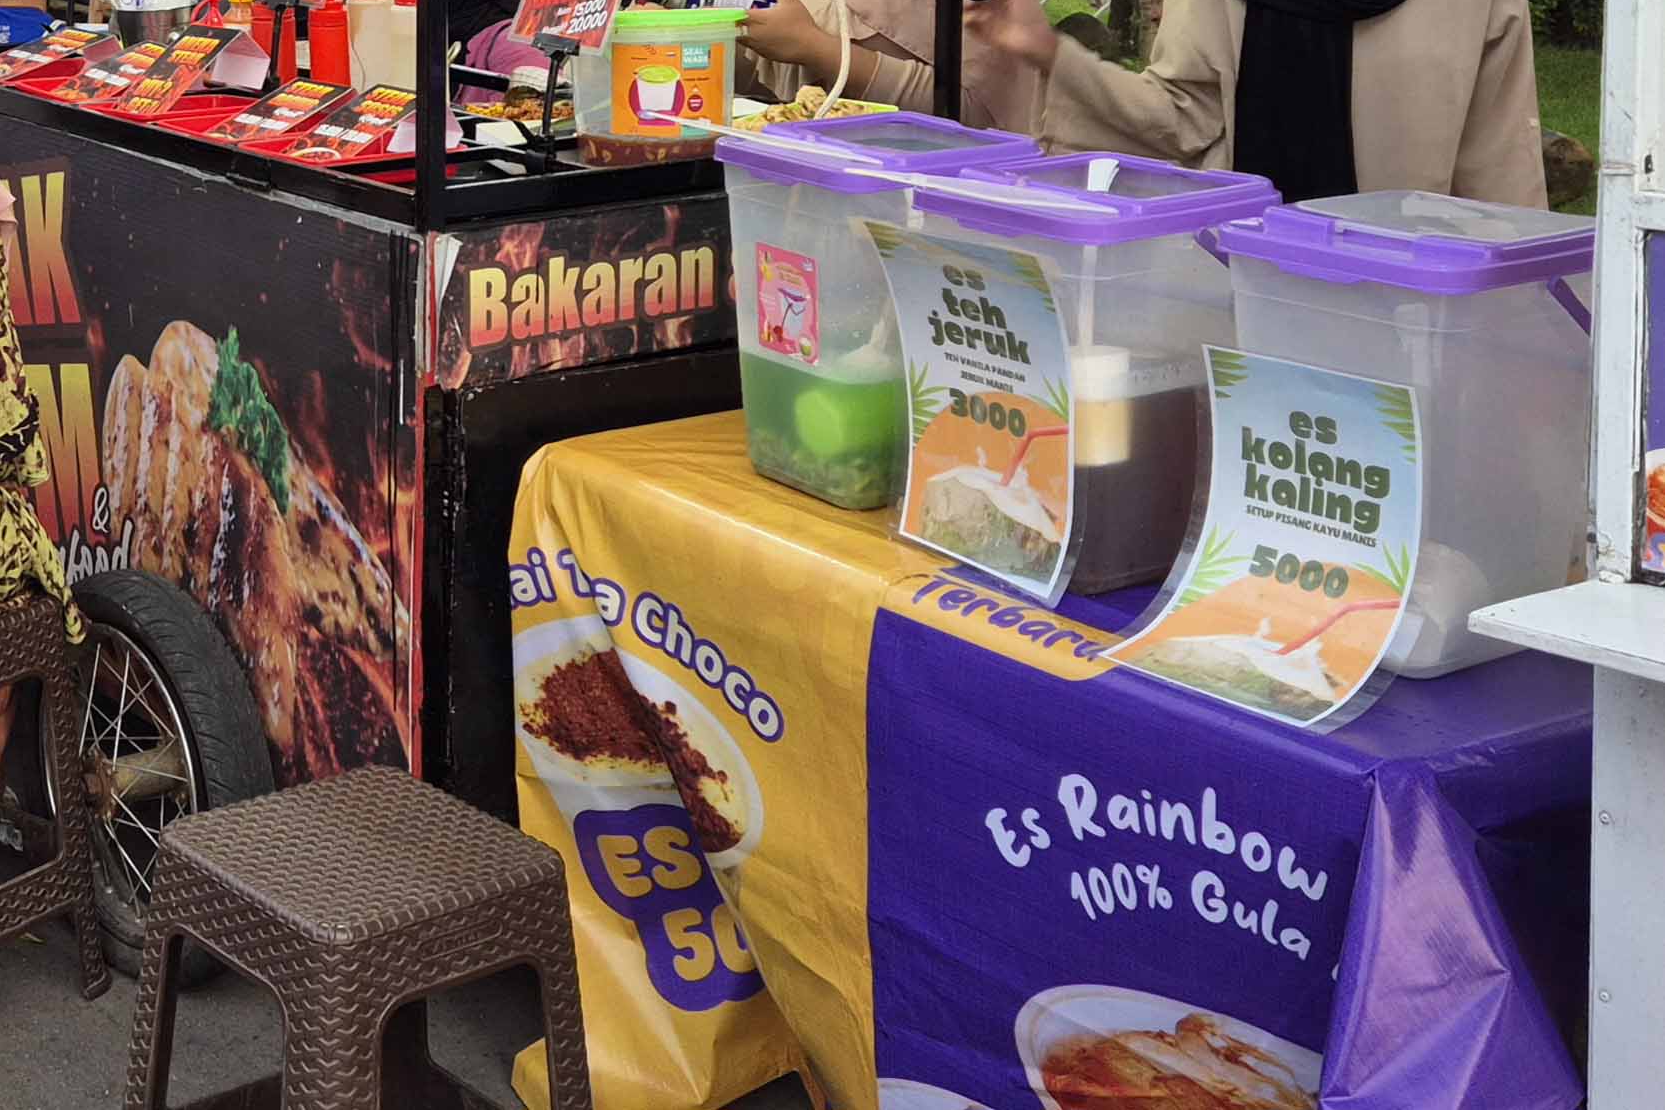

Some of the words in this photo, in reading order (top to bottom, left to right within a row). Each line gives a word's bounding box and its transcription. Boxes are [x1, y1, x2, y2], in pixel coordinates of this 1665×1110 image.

[469, 245, 715, 348] Bakaran
[942, 265, 986, 292] es
[942, 288, 1008, 330] teh
[927, 310, 1032, 365] jeruk
[949, 387, 1026, 437] 3000
[1288, 410, 1339, 445] es
[1241, 426, 1392, 499] kolang
[92, 487, 111, 533] &
[1243, 462, 1382, 534] kaling
[1246, 504, 1274, 520] SETUP
[1275, 512, 1312, 530] PISANG
[1312, 522, 1341, 539] KAYU
[1341, 529, 1377, 548] MANIS
[1248, 543, 1350, 599] 5000
[632, 591, 784, 742] Choco
[595, 825, 703, 899] ES
[985, 807, 1052, 868] Es
[1057, 773, 1329, 901] Rainbow
[1070, 862, 1174, 922] 100%
[1190, 869, 1312, 960] Gula
